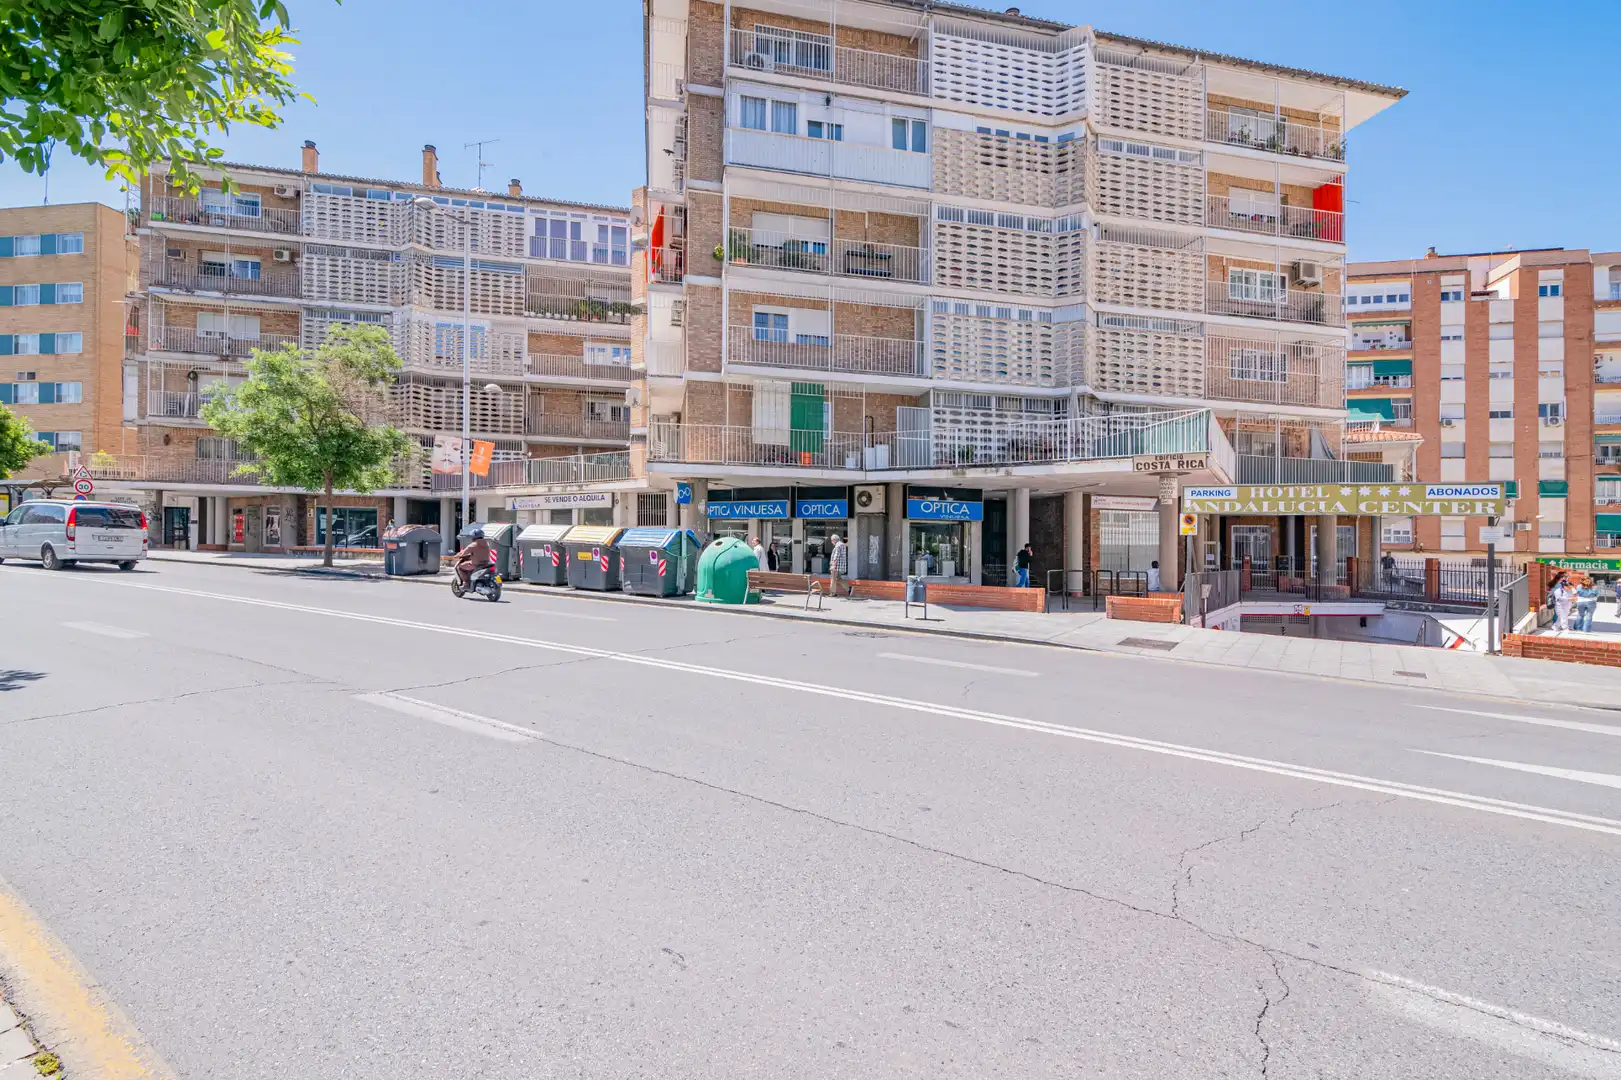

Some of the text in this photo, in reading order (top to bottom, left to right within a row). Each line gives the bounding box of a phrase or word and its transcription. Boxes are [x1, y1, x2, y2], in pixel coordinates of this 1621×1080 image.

[1136, 459, 1205, 471] COSTA RICA
[1190, 489, 1231, 497] PARKING
[1249, 486, 1330, 499] HOTEL
[1427, 487, 1499, 496] ABONADOS
[552, 495, 572, 503] VENDE
[579, 494, 606, 502] ALQUILA
[733, 504, 783, 515] VINUESA
[801, 504, 841, 515] OPTICA
[920, 501, 970, 515] OPTICA
[1186, 500, 1497, 514] ANDALUCIA CENTER
[1558, 558, 1609, 570] farmacia
